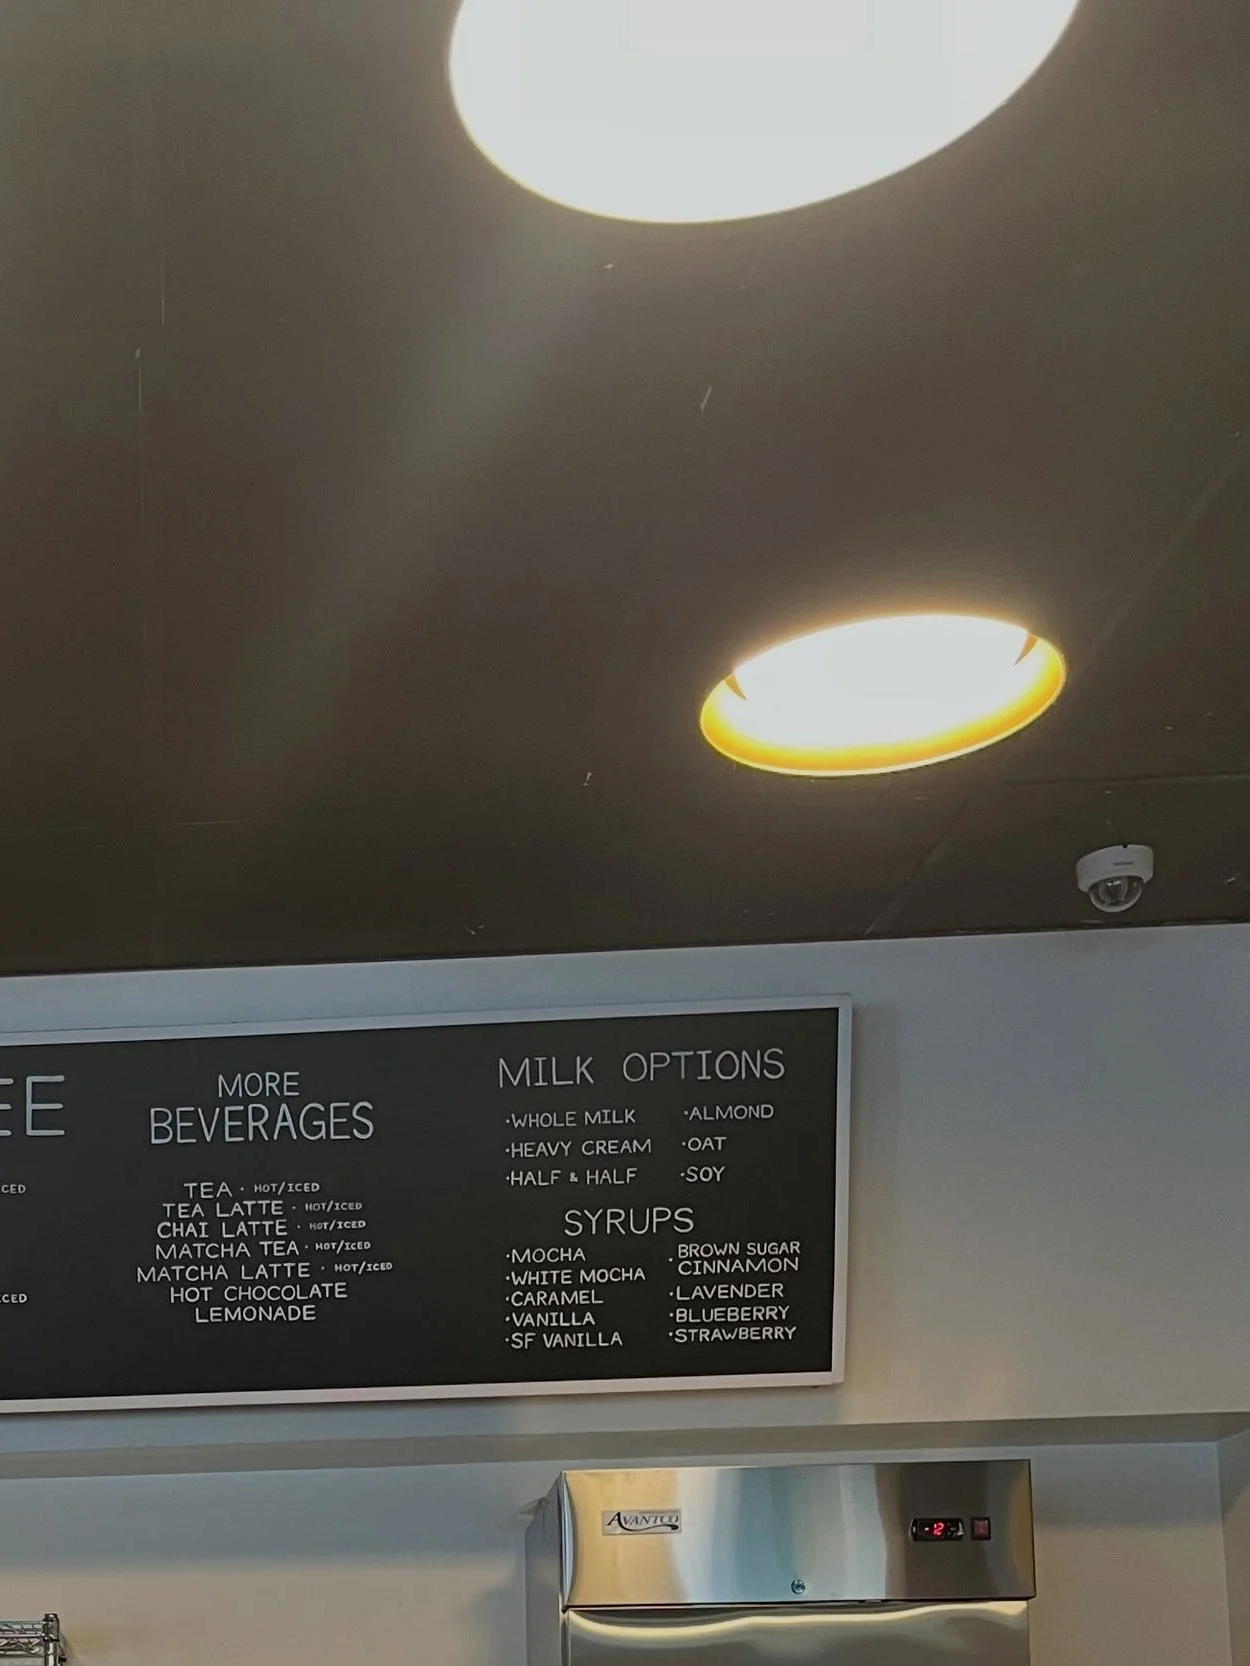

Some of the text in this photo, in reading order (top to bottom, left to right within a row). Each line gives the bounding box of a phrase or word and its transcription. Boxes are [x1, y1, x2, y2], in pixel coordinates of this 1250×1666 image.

[498, 1047, 785, 1089] MILK OPTIONS
[218, 1071, 300, 1098] MORE
[511, 1108, 636, 1129] WHOLE MILK
[688, 1104, 774, 1121] ALMOND
[150, 1101, 374, 1145] BEVERAGES
[511, 1138, 652, 1159] HEAVY CREAM
[687, 1136, 727, 1152] OAT
[510, 1167, 638, 1186] HALF & HALF
[685, 1165, 726, 1183] SOY
[183, 1181, 320, 1199] TEA HOT/ICED
[161, 1199, 363, 1219] TEA LATTE HOT/ICED
[156, 1218, 367, 1239] CHAI LATTE HOT/ICED
[564, 1206, 694, 1237] SYRUPS
[155, 1239, 371, 1260] MATCHA TEA HOT/ICED
[511, 1247, 586, 1264] MOCHA
[677, 1240, 801, 1259] BROWN SUGAR
[137, 1260, 393, 1283] MATCHA LATTE HOT/ICED
[677, 1256, 799, 1276] CINNAMON
[510, 1267, 646, 1286] WHITE MOCHA
[170, 1281, 348, 1304] HOT CHOCOLATE
[510, 1289, 604, 1307] CARAMEL
[676, 1282, 784, 1301] LAVENDER
[195, 1304, 317, 1323] LEMONADE
[511, 1311, 596, 1327] VANILLA
[675, 1305, 790, 1323] BLUEBERRY
[510, 1331, 623, 1350] SF VANILLA
[674, 1326, 797, 1343] STRAWBERRY
